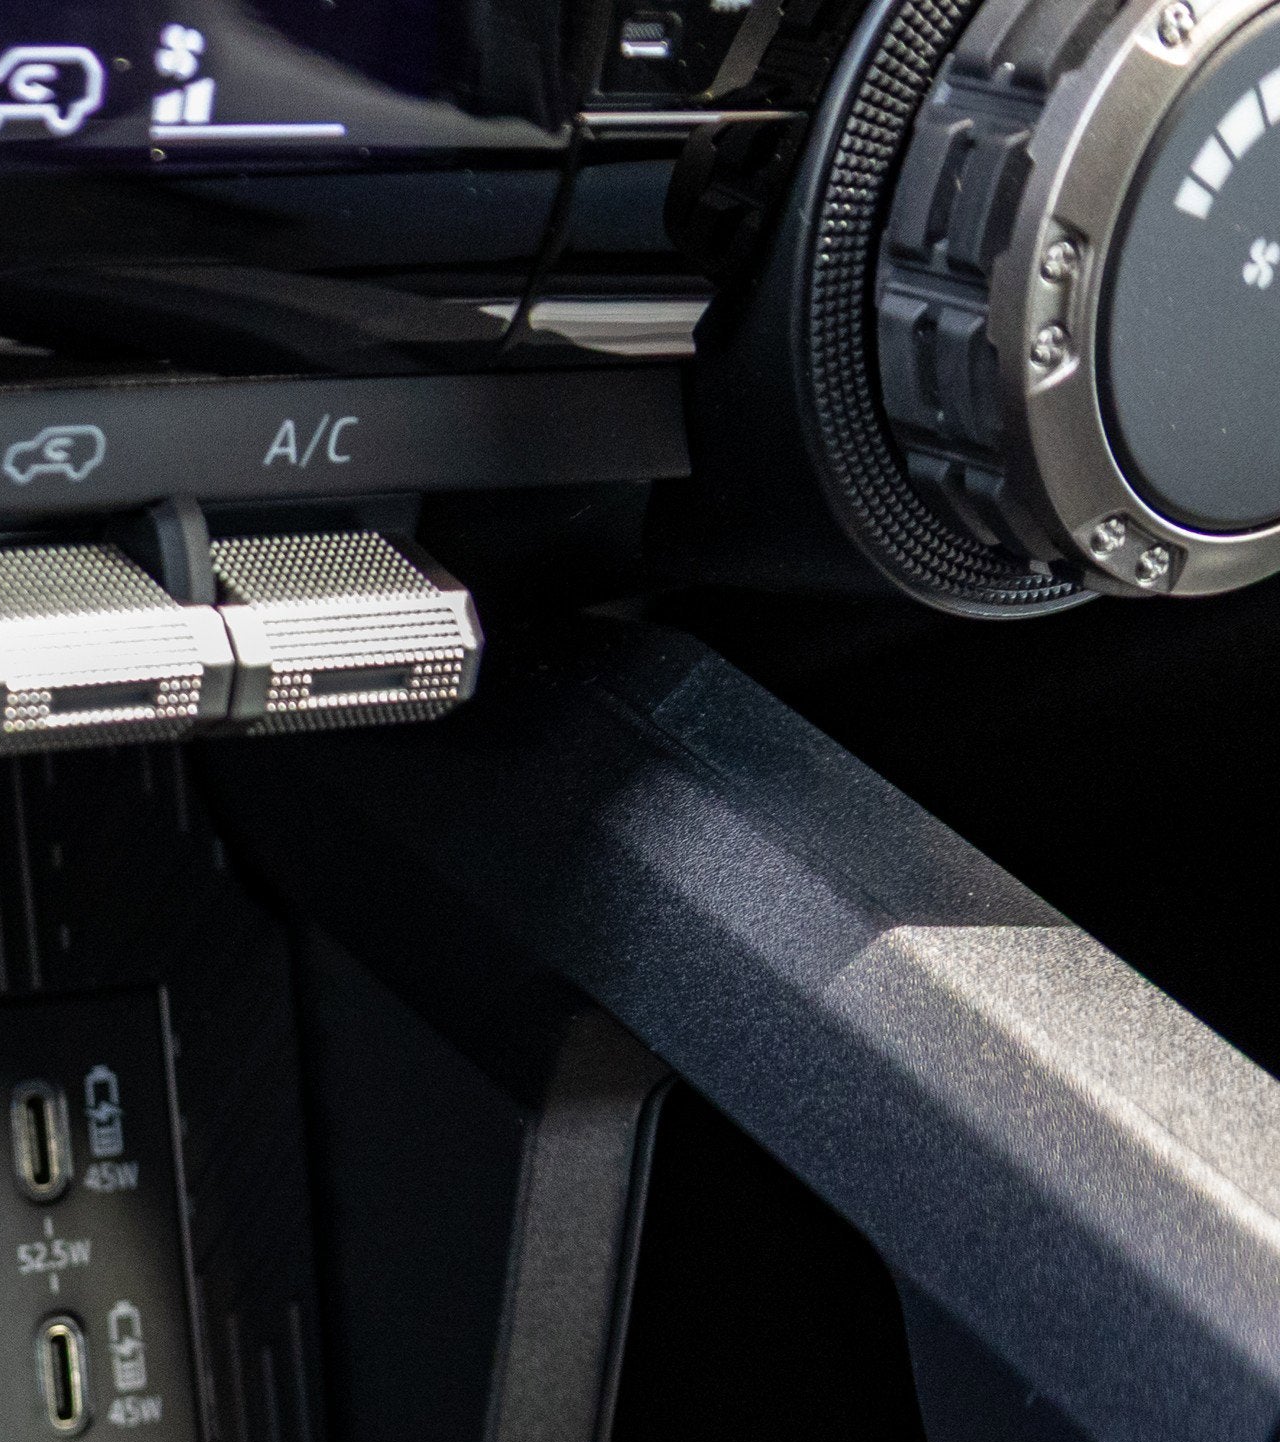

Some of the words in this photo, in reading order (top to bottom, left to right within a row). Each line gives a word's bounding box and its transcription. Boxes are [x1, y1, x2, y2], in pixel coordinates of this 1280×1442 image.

[263, 414, 358, 467] A/C
[85, 1161, 139, 1191] 45W
[17, 1239, 90, 1273] 52.5W
[108, 1395, 162, 1426] 45W
